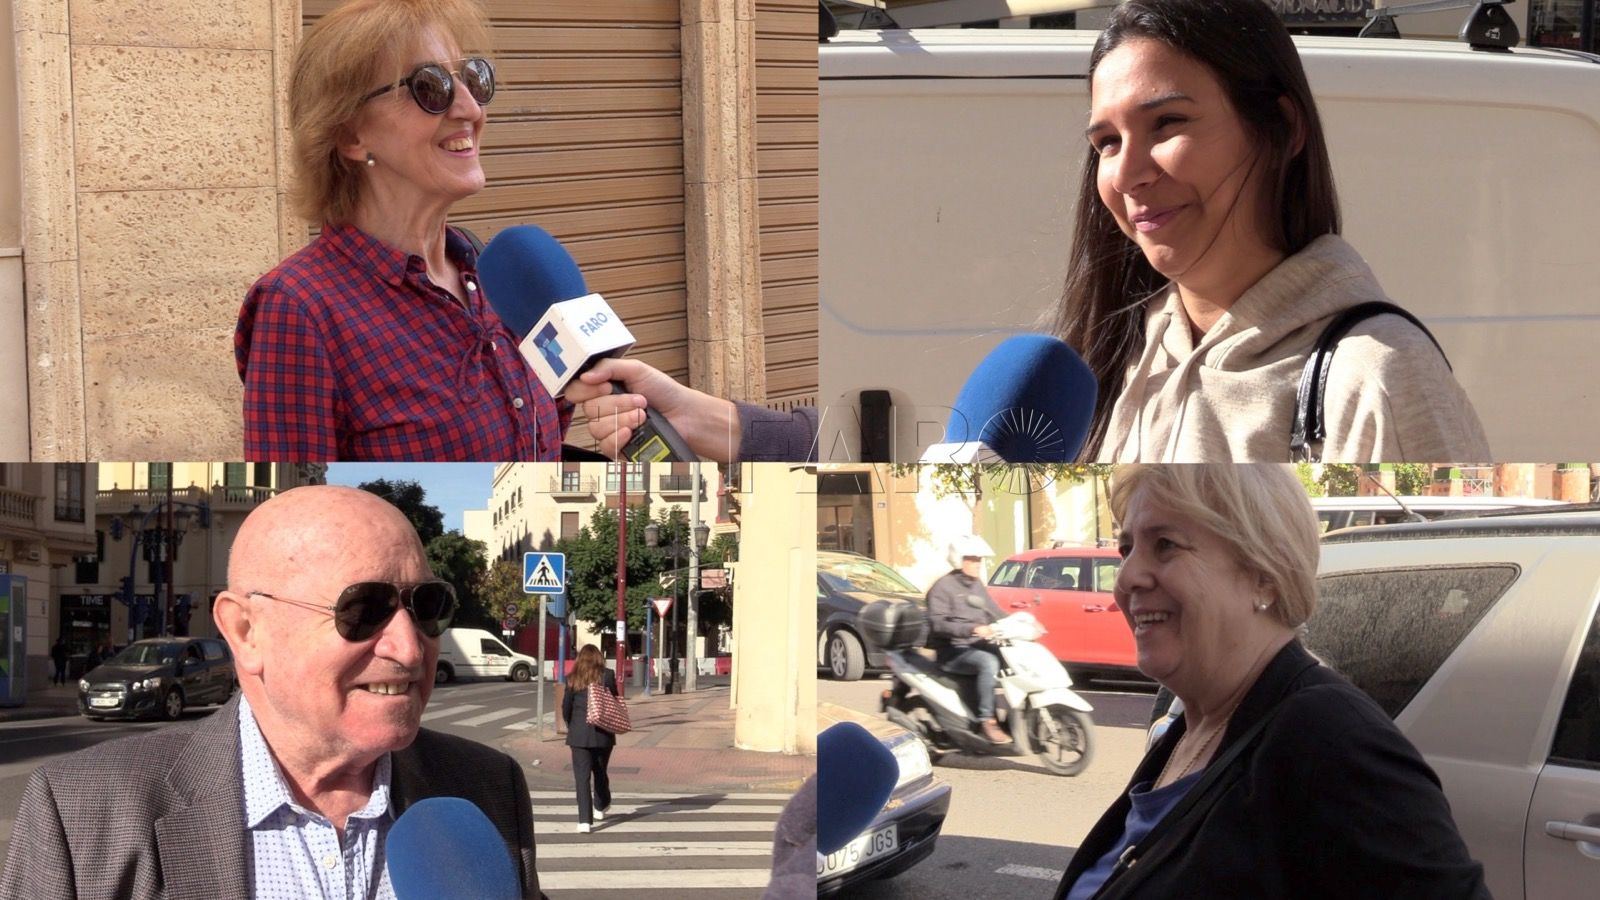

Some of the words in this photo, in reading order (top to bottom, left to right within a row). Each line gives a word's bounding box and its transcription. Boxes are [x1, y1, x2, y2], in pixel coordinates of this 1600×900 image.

[579, 312, 608, 337] FARO
[80, 595, 104, 606] TIME
[816, 843, 860, 876] 075
[866, 829, 893, 857] JGS
